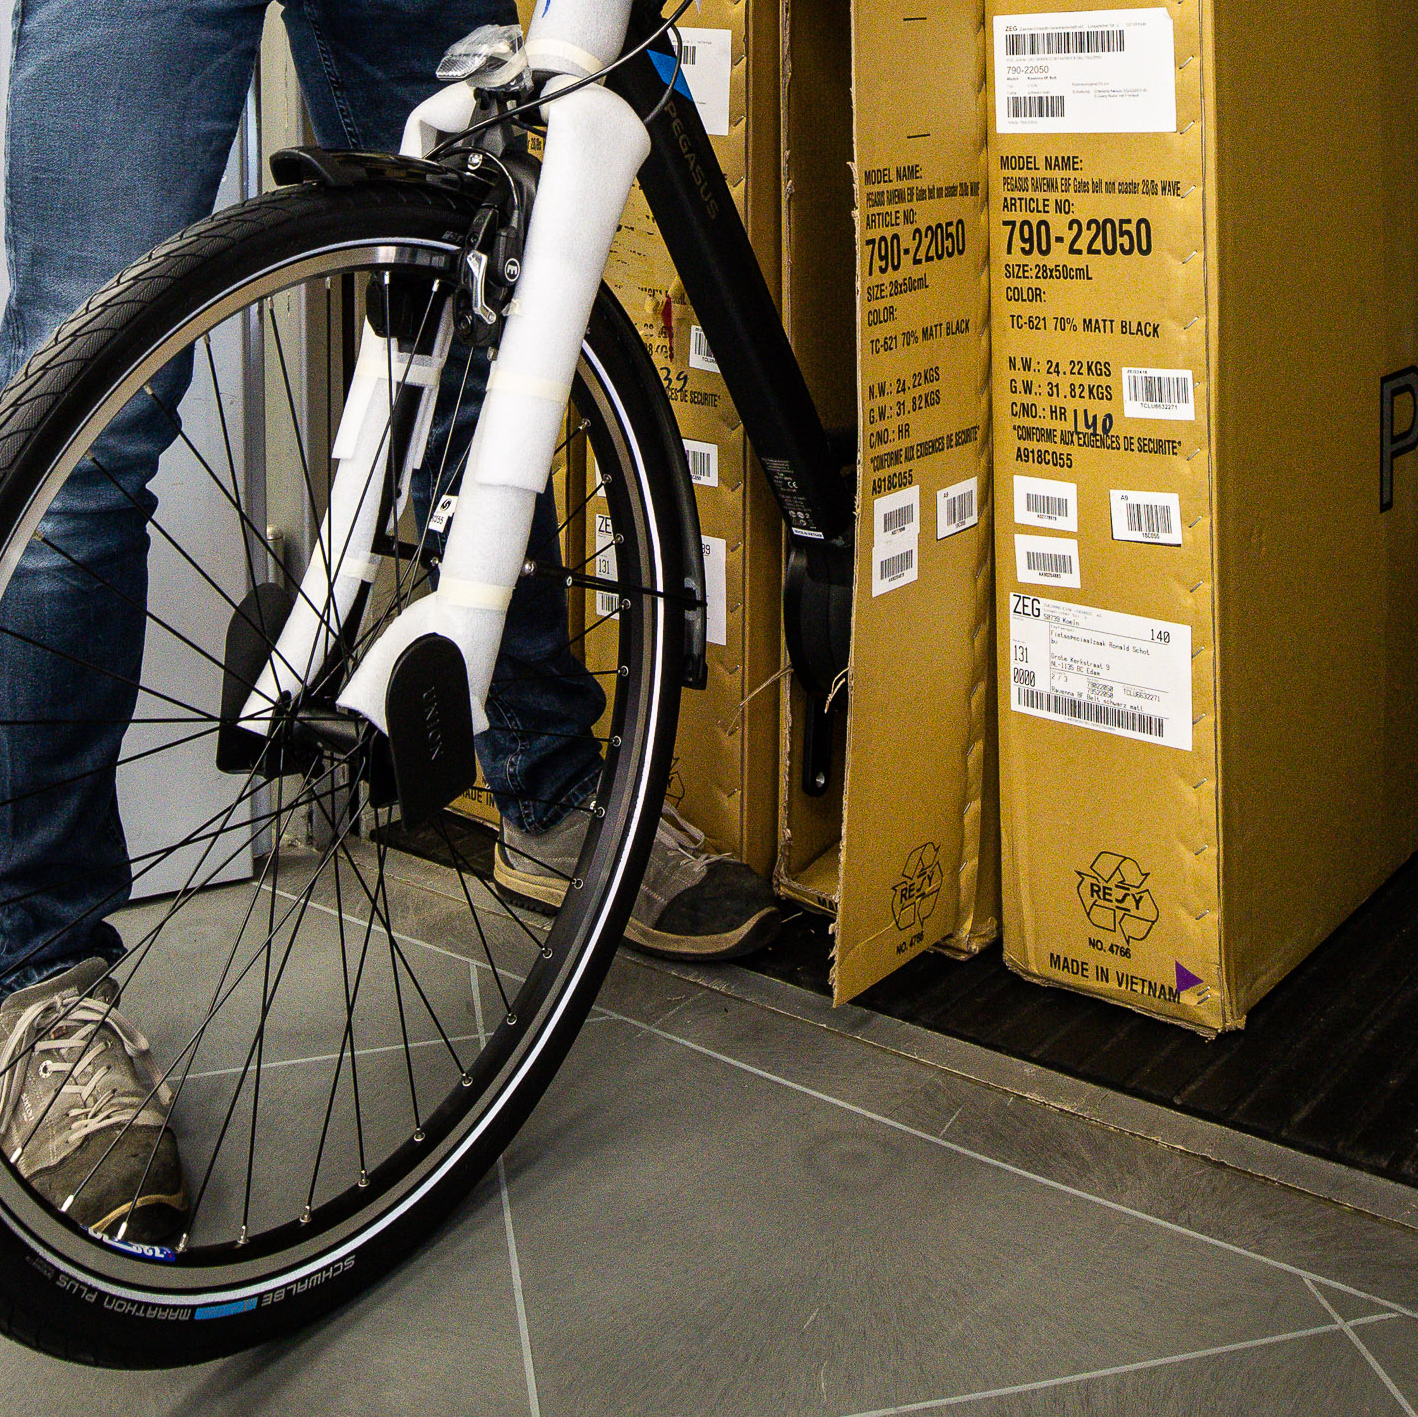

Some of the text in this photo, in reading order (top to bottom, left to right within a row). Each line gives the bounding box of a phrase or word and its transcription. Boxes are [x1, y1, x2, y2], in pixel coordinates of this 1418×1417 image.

[1006, 65, 1050, 75] 790-22050
[664, 101, 720, 220] PEGASUS
[1000, 156, 1084, 171] MODEL NAME:
[864, 164, 923, 185] MODEL NAME:
[1002, 176, 1030, 193] PEGASUS
[1030, 177, 1059, 193] RAVENNA
[1073, 178, 1090, 194] Gates
[1091, 178, 1103, 194] belt
[1104, 180, 1116, 195] non
[1117, 179, 1140, 195] coaster
[1160, 180, 1181, 198] WAVE
[1002, 197, 1075, 215] ARTICLE NO:
[865, 208, 917, 230] ARTICLE NO:
[865, 218, 966, 277] 790-22050
[1001, 218, 1153, 257] 790-22050
[1005, 286, 1047, 303] COLOR:
[867, 305, 898, 328] COLOR:
[1009, 314, 1160, 339] TC-621 70% MATT BLACK
[870, 318, 970, 356] TC-621 70% MATT BLACK
[1008, 356, 1041, 373] N.W.:
[1086, 360, 1112, 377] KGS
[868, 366, 941, 401] N.W.: KGS
[1009, 378, 1042, 397] G.W.:
[1087, 384, 1113, 402] KGS
[869, 390, 941, 425] G.W.: KGS
[1010, 401, 1068, 422] C/NO.: HR
[1073, 408, 1114, 436] 140
[869, 423, 911, 449] C/NO.: HR
[1059, 429, 1075, 446] AUX
[1076, 432, 1121, 451] EXIGENCES
[1123, 436, 1135, 452] DE
[904, 434, 954, 462] AUX EXIGENCES DE
[1015, 447, 1074, 469] A918C055
[871, 469, 913, 496] A918C055
[598, 558, 610, 575] 131
[1012, 594, 1041, 618] ZEG
[1150, 628, 1171, 644] 140
[1014, 645, 1029, 664] 131
[1013, 667, 1036, 688] 0000
[896, 941, 908, 956] NO.
[1088, 937, 1132, 960] NO. 4766
[1049, 953, 1182, 1005] MADE IN VIETNAM
[261, 1254, 357, 1308] SCHWALBE
[56, 1272, 192, 1321] MARATHON PLUS
